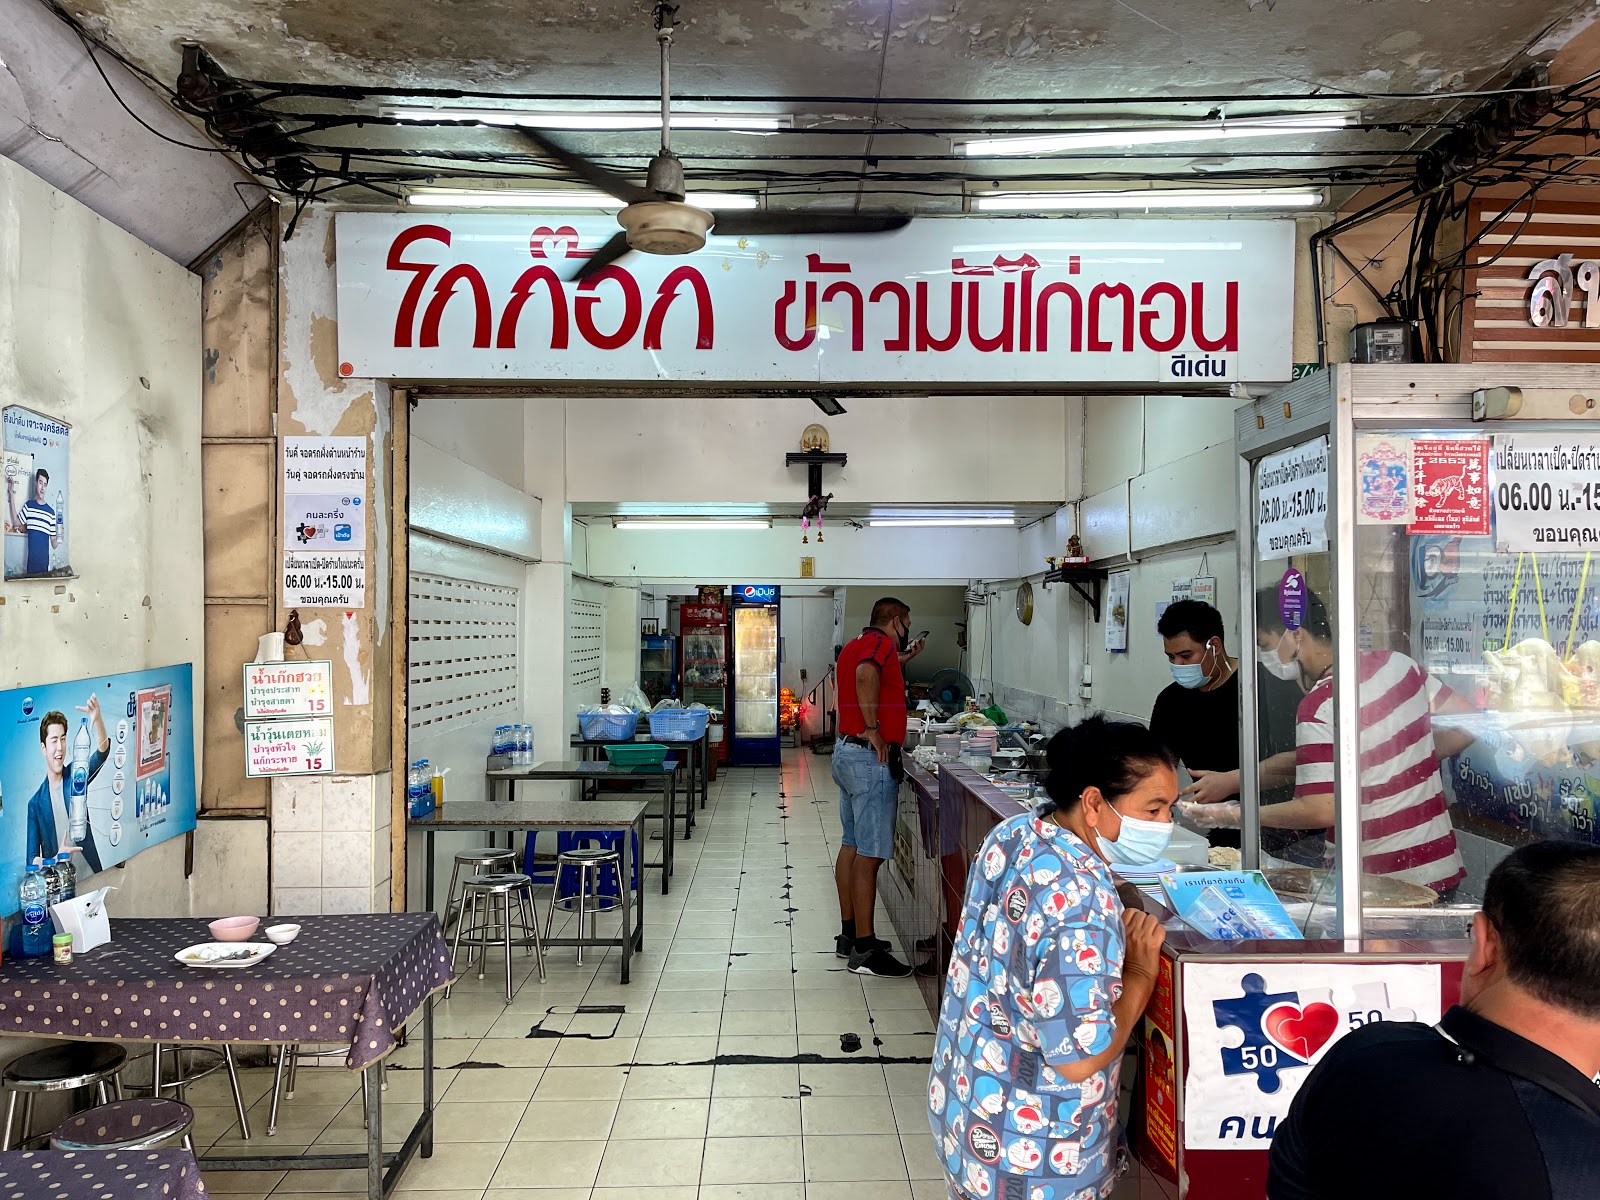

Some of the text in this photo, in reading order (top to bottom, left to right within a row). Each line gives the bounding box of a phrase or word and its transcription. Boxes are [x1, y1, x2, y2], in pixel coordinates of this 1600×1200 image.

[775, 253, 1239, 352] ข้าวมันไก่ตอน
[1171, 354, 1226, 377] ดีเด่น
[1498, 483, 1552, 511] 06.00
[306, 508, 344, 519] คนละครึ่ง
[1260, 496, 1280, 525] 06.00
[1269, 527, 1312, 552] ขอบคุณครับ
[1533, 527, 1600, 547] ขอบคุณ
[286, 574, 312, 589] 06.00
[300, 594, 349, 606] ขอบคุณครับ
[252, 668, 322, 684] น้ำเก๊กฮวย
[308, 699, 325, 711] 15
[253, 742, 296, 754] บำรุงหัวใจ
[253, 756, 322, 770] แก้กระหาย 15
[1241, 1044, 1278, 1069] 50
